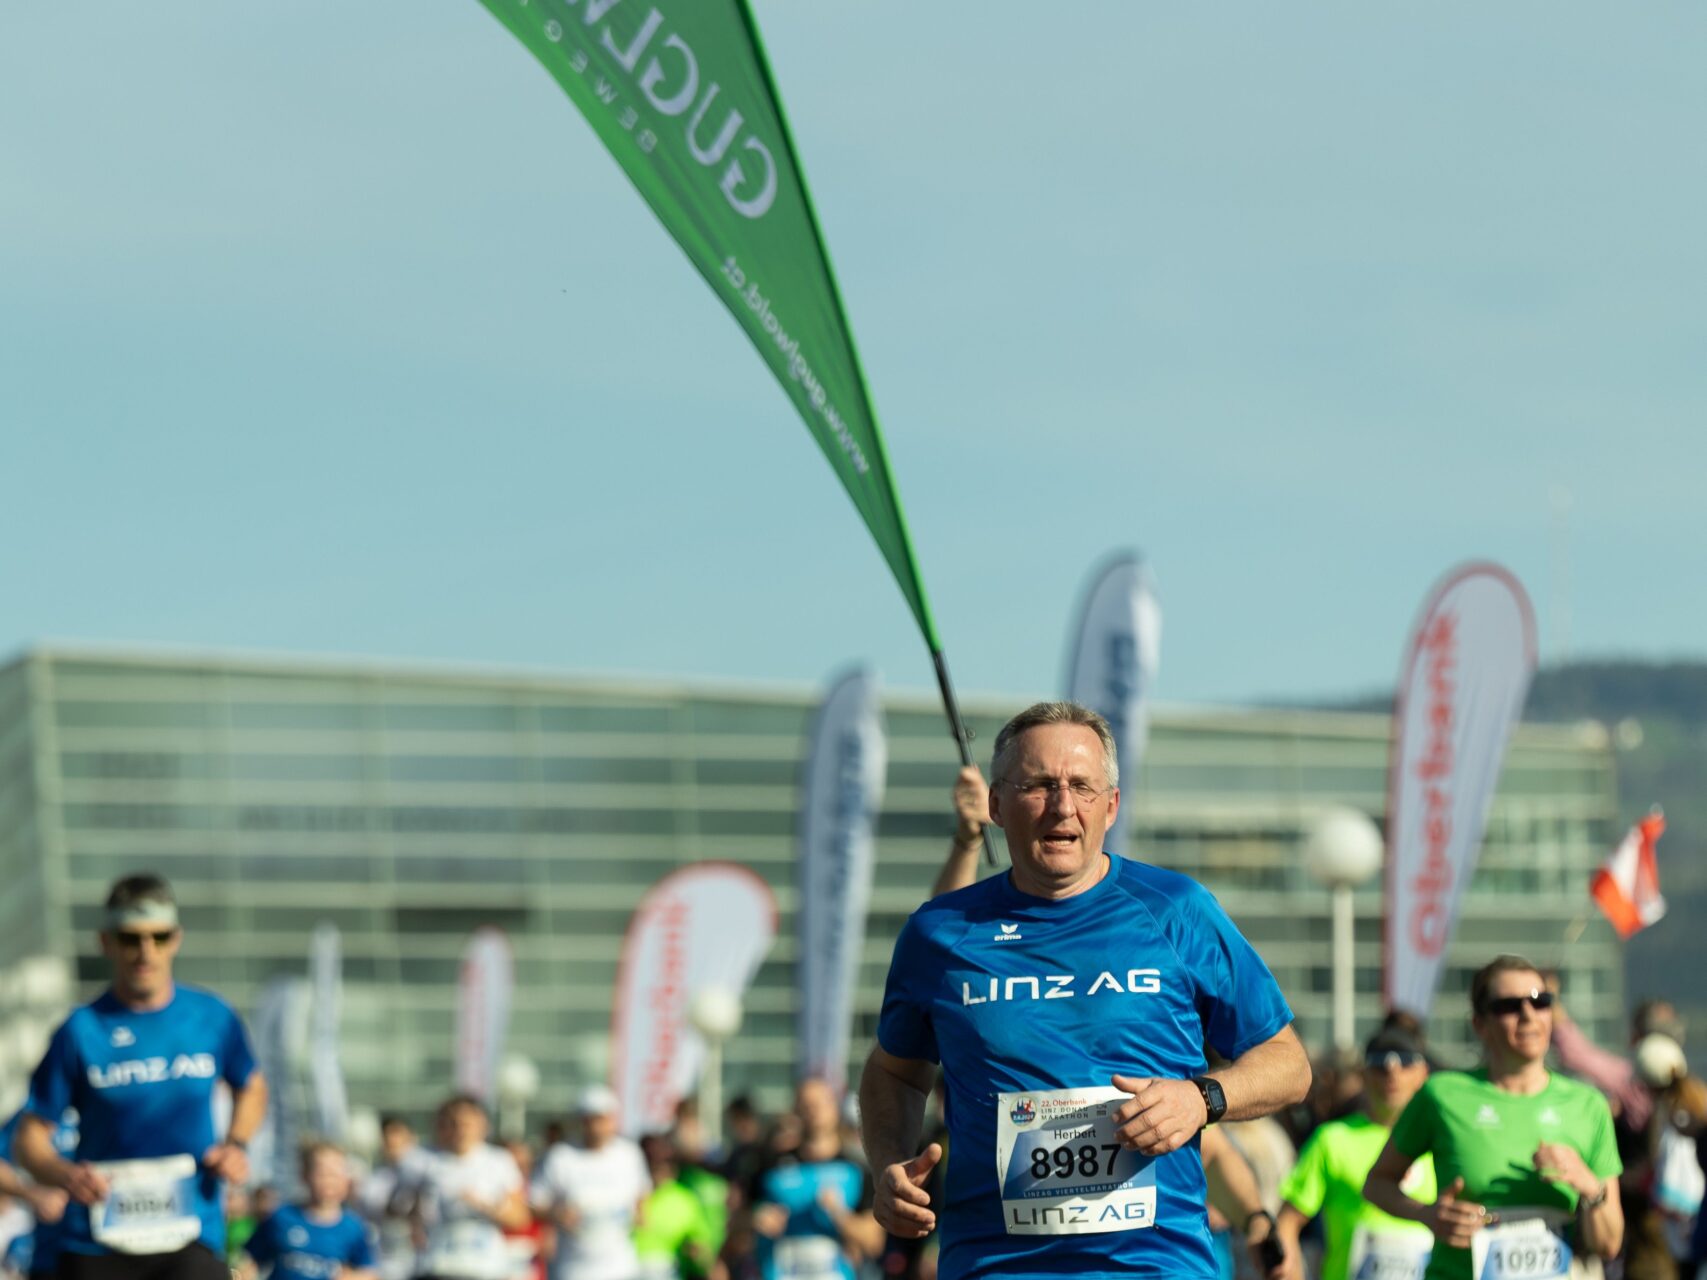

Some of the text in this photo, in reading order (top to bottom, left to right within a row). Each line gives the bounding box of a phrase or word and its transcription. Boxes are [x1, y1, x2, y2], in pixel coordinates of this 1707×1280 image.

[1406, 607, 1459, 959] Oberbank
[994, 934, 1022, 942] erima
[962, 968, 1161, 1006] LINZ AG
[1053, 1098, 1087, 1107] Oberbank
[1041, 1112, 1089, 1121] MARATHON
[1054, 1128, 1097, 1140] Herbert
[1030, 1144, 1122, 1179] 8987
[1013, 1203, 1146, 1225] LINZ AG
